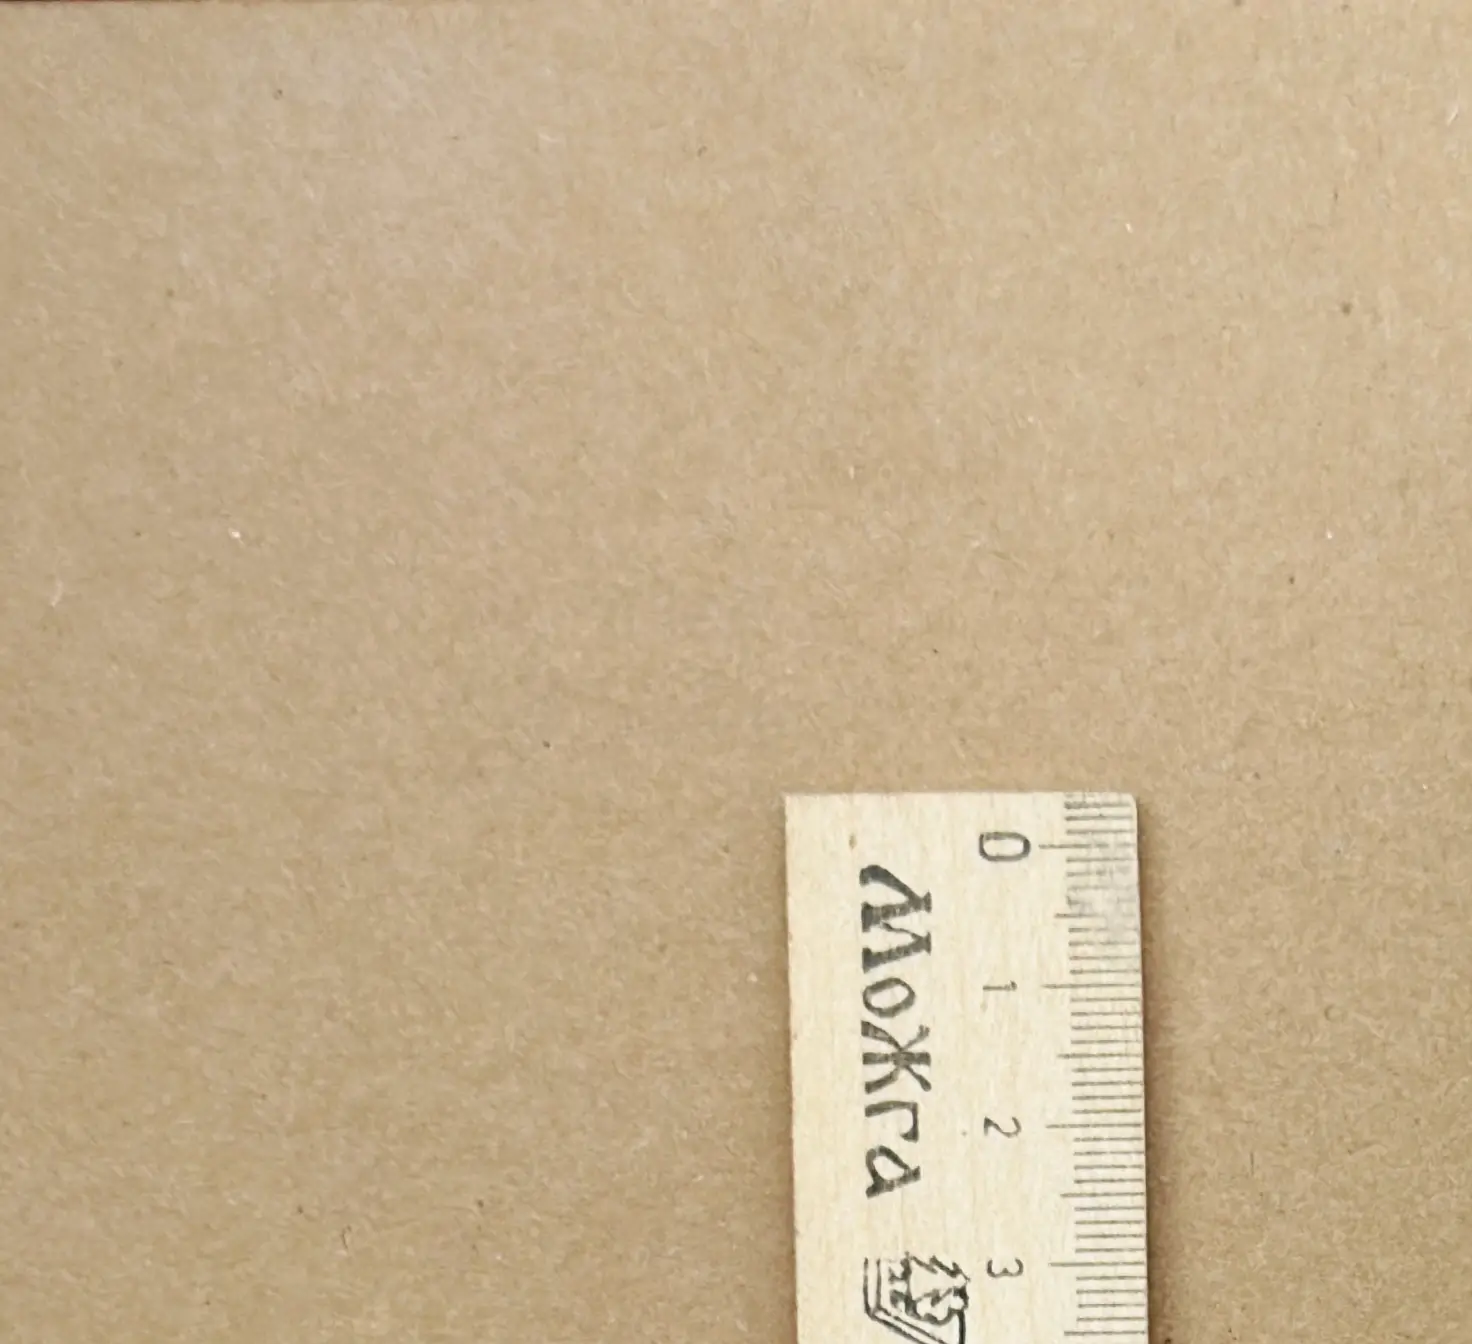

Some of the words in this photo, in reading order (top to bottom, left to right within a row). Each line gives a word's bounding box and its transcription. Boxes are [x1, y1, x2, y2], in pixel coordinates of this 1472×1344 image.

[978, 831, 1031, 862] 0
[982, 980, 1018, 992] 1
[983, 1116, 1022, 1139] 2
[986, 1258, 1024, 1279] 3
